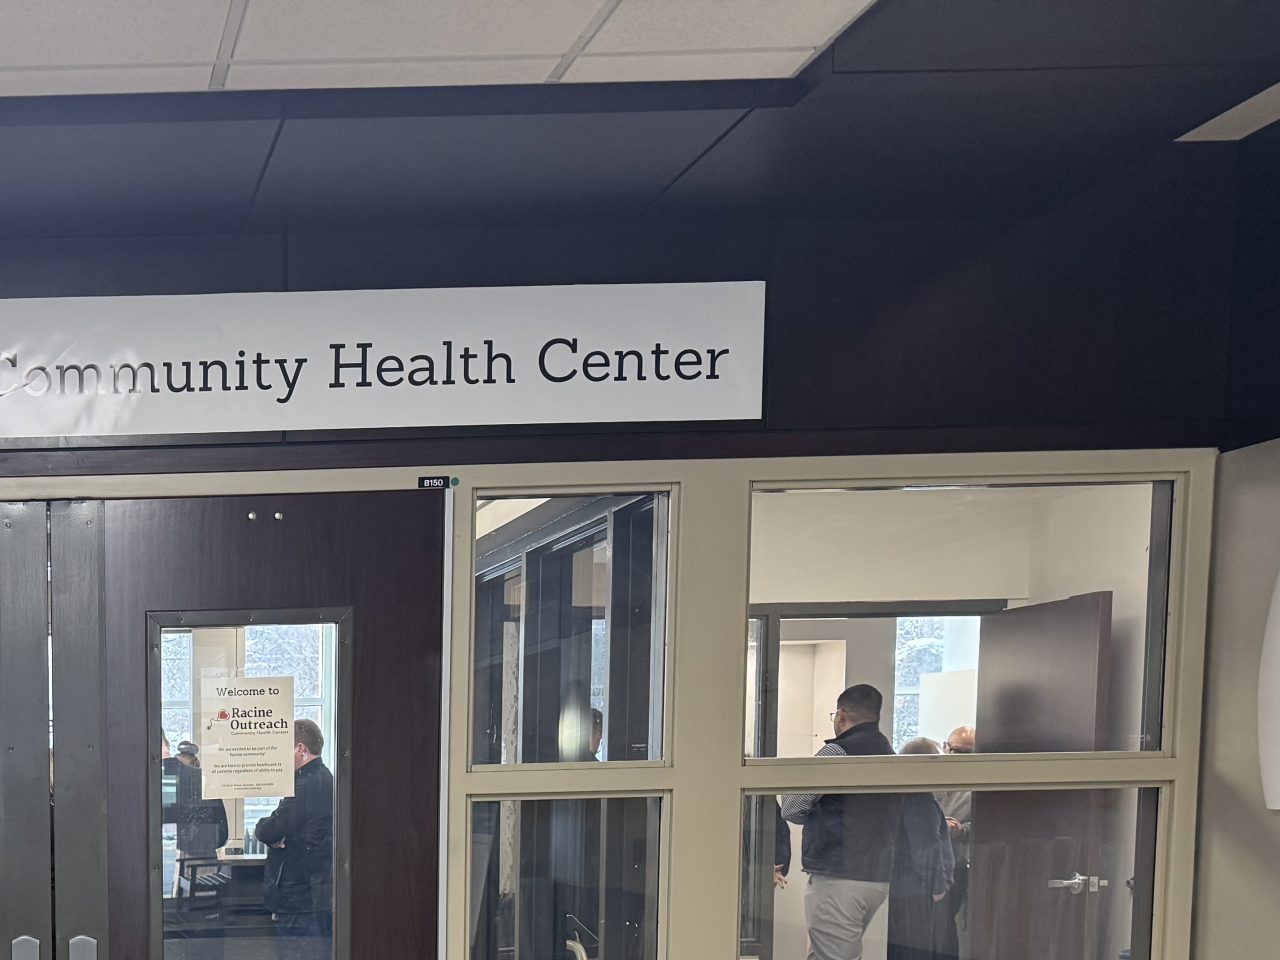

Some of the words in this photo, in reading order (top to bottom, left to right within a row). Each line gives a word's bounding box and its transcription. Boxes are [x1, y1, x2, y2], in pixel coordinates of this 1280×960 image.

[328, 339, 516, 389] Health
[537, 337, 730, 384] Center
[423, 479, 444, 487] B150
[216, 687, 266, 697] Welcome
[268, 687, 280, 696] to
[231, 706, 273, 718] Racine
[230, 718, 289, 730] Outreach
